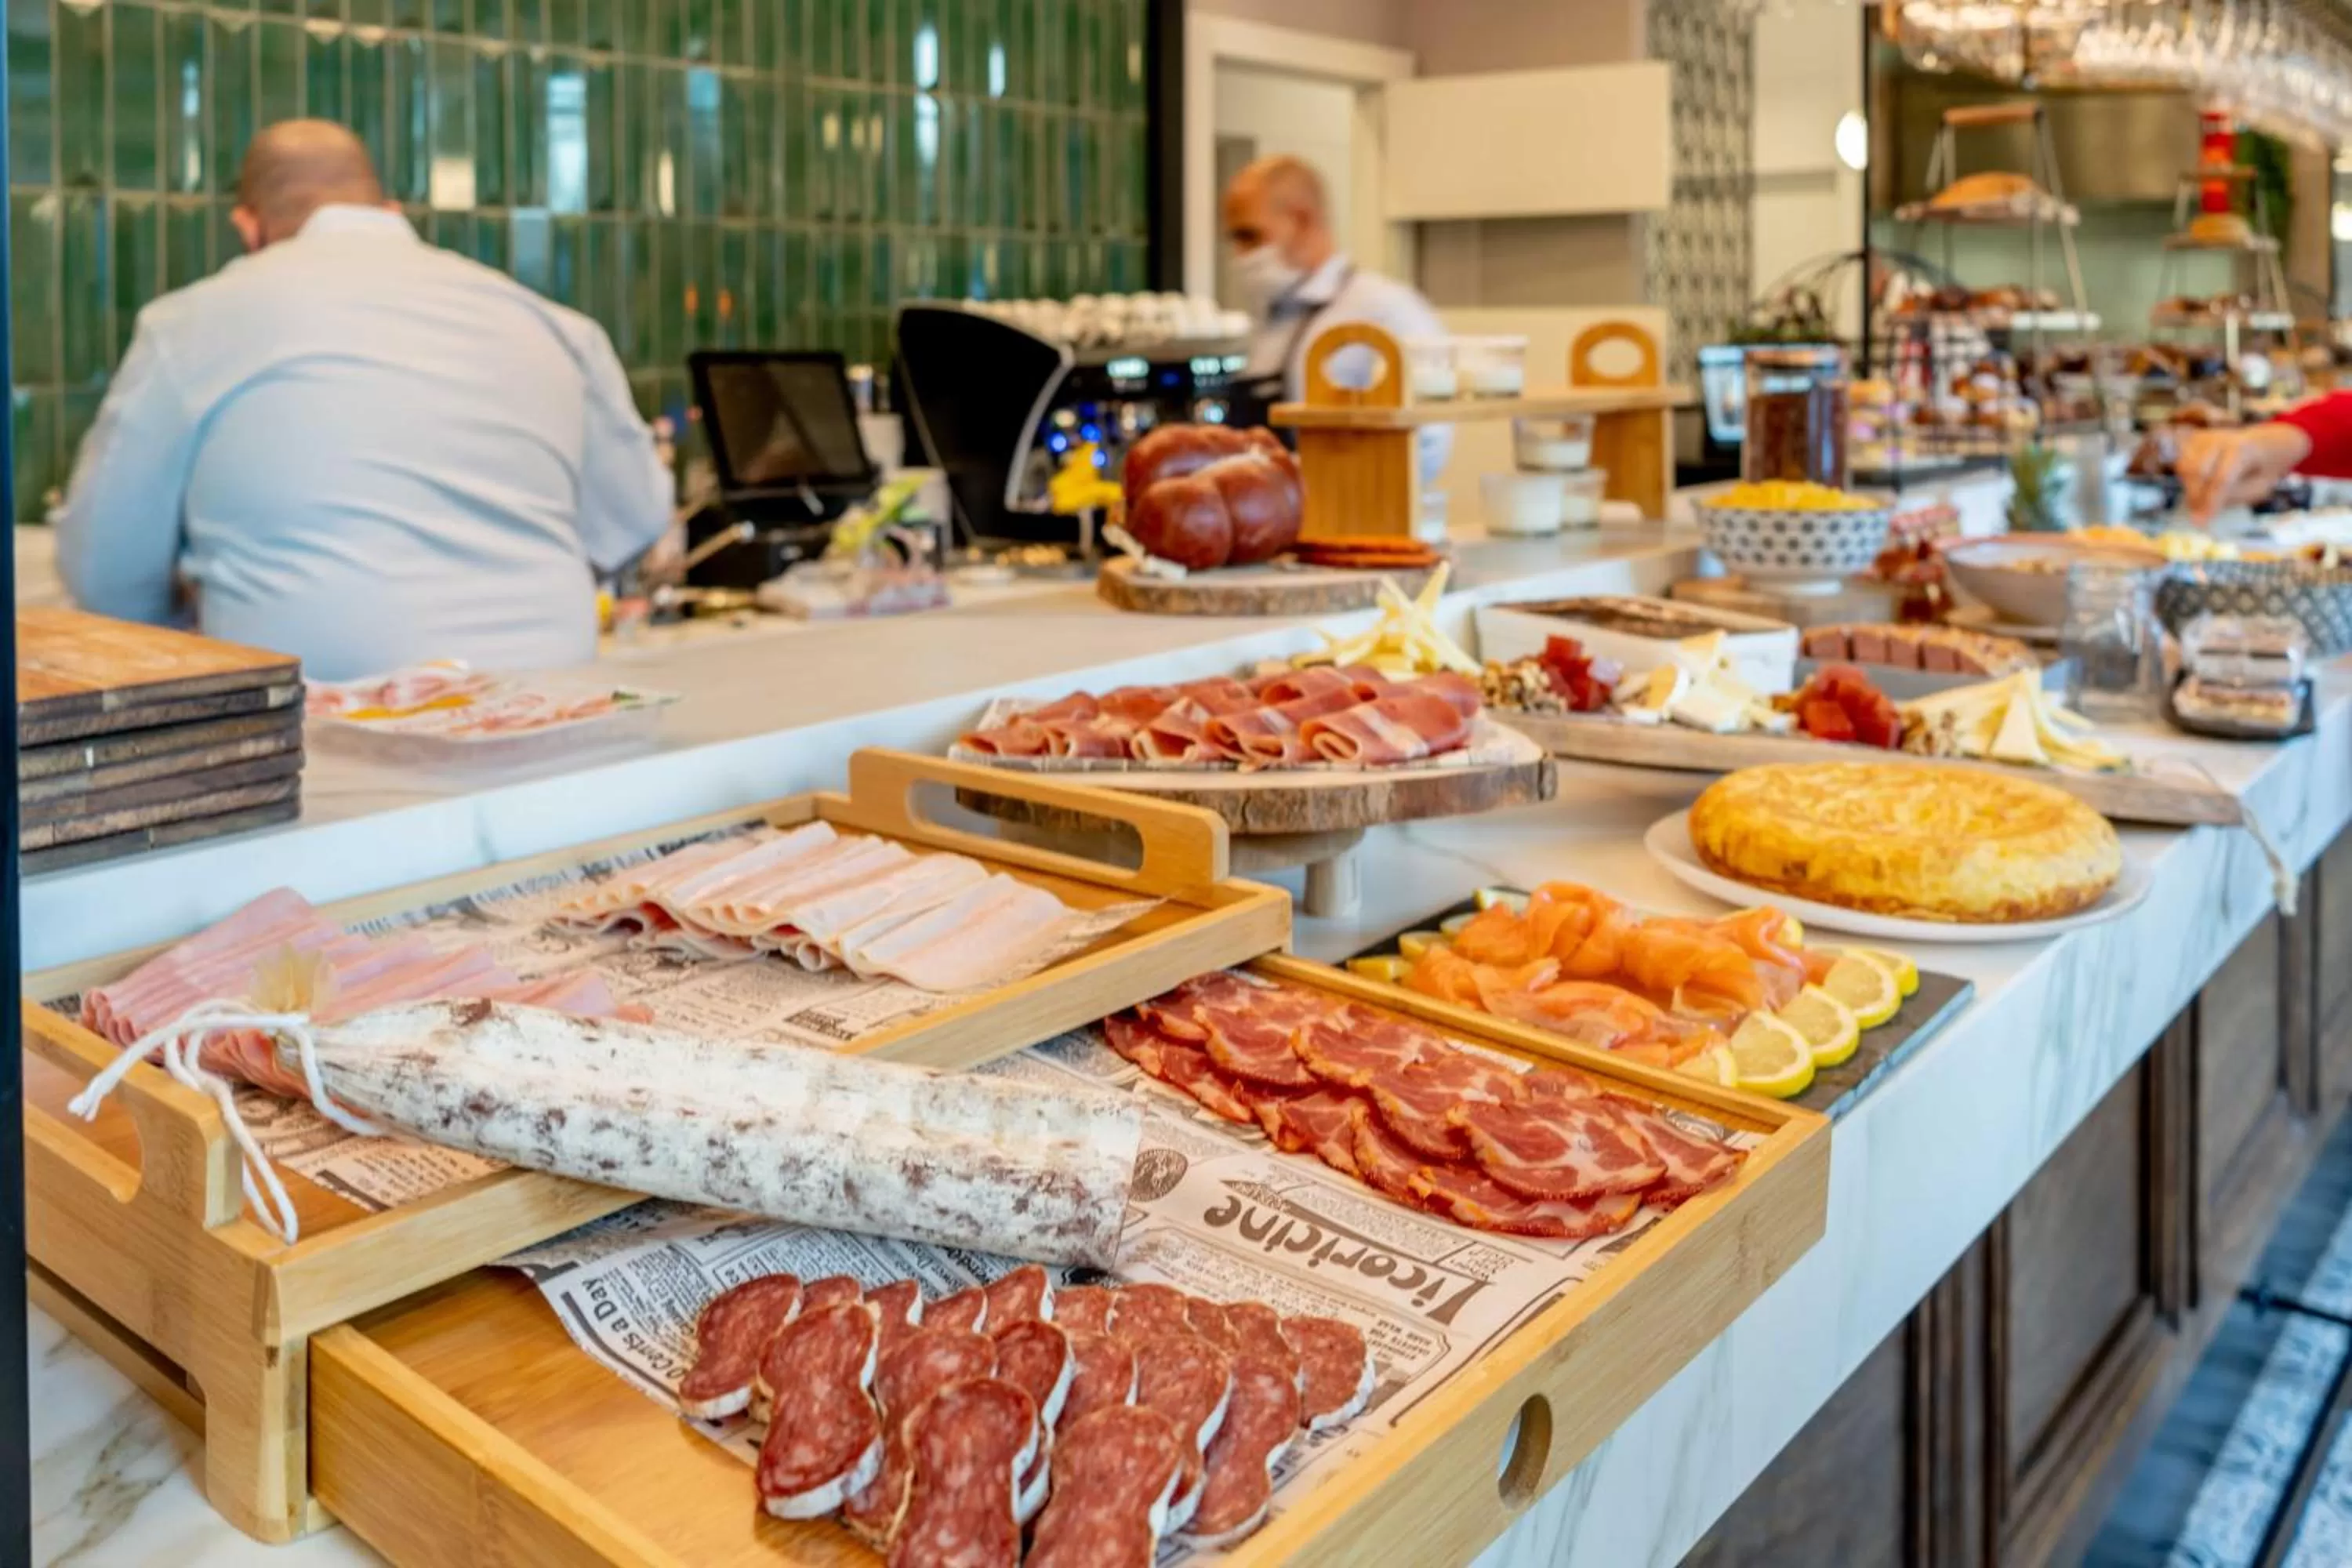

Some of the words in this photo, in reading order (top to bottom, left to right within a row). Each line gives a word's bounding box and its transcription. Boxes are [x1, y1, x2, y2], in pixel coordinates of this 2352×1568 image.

[1203, 1193, 1488, 1325] Licoricine
[582, 1277, 618, 1321] Day
[611, 1317, 630, 1333] a
[622, 1332, 673, 1370] Cents
